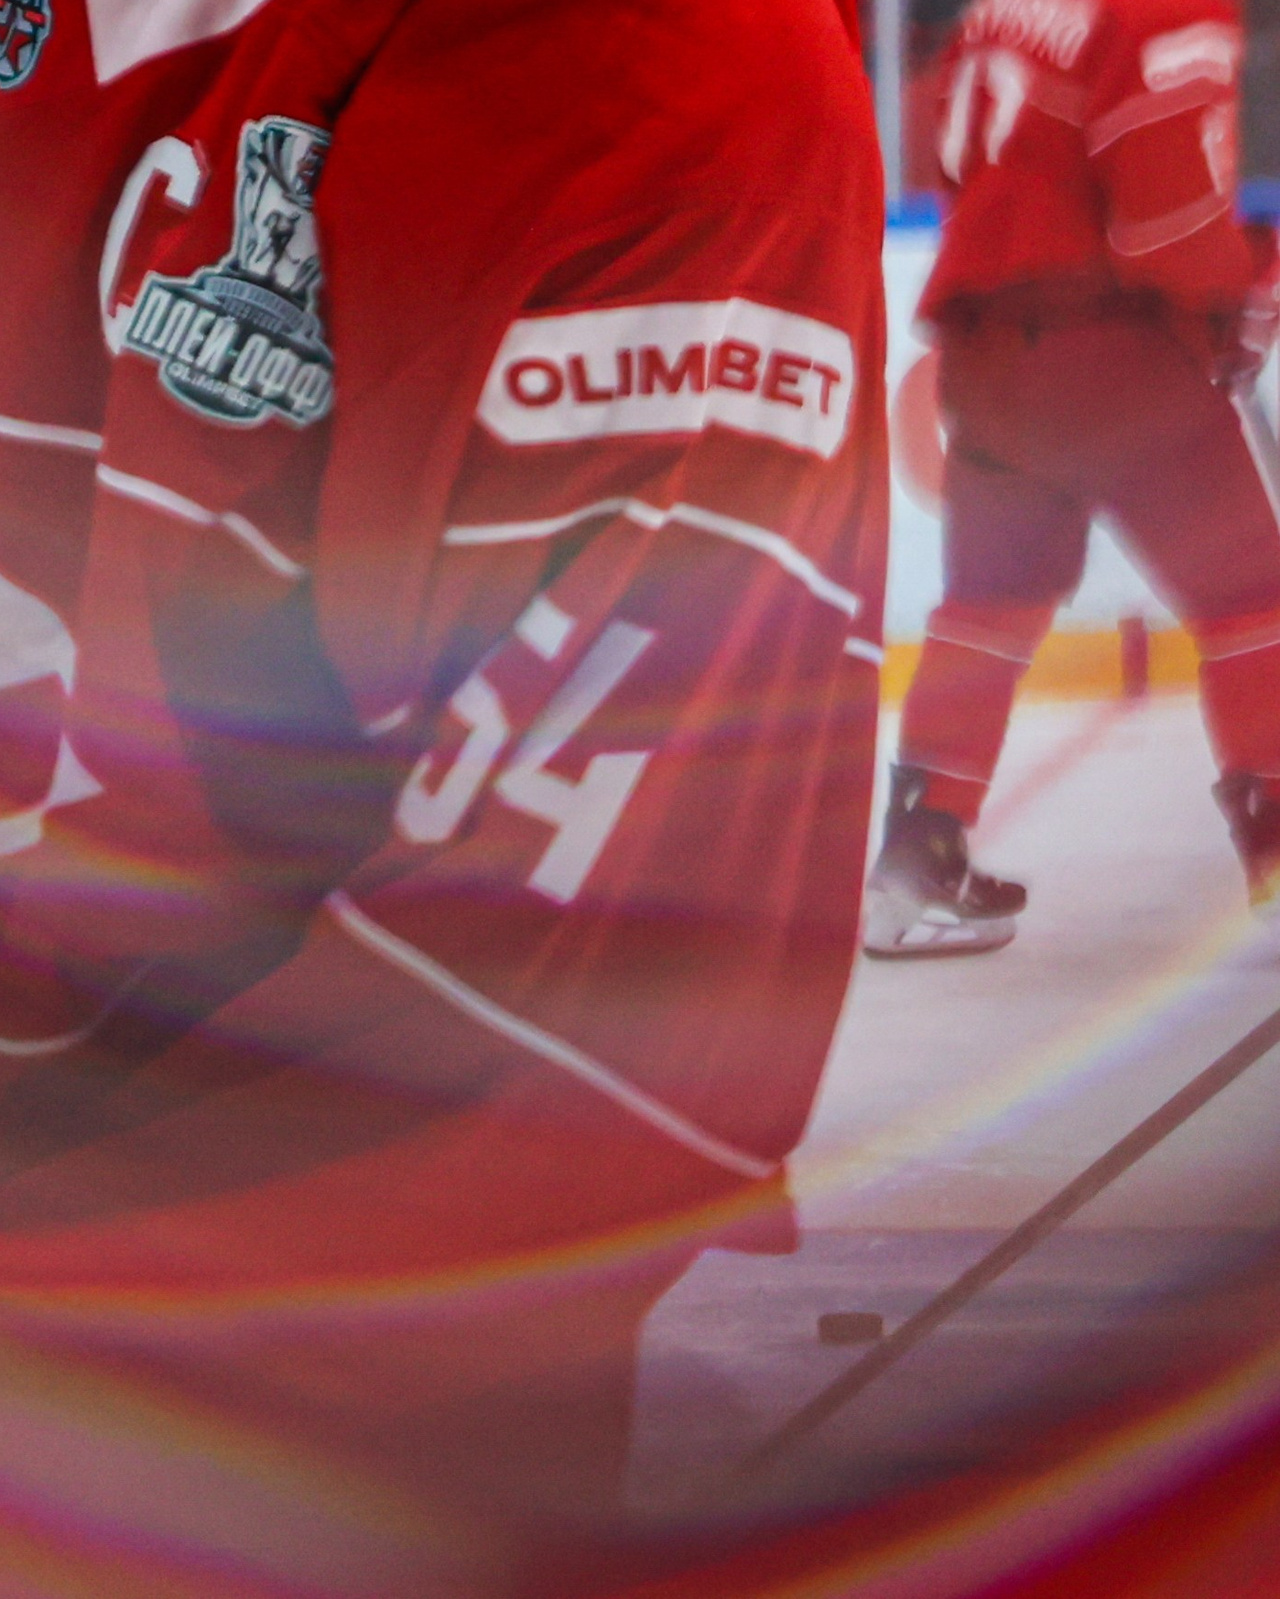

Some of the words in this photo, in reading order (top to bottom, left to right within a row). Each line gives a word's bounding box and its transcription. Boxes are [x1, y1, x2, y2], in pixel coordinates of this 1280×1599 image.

[132, 286, 331, 412] ПЛЕЙ-ОФФ
[504, 336, 842, 415] OLIMBET
[394, 593, 656, 905] 54
